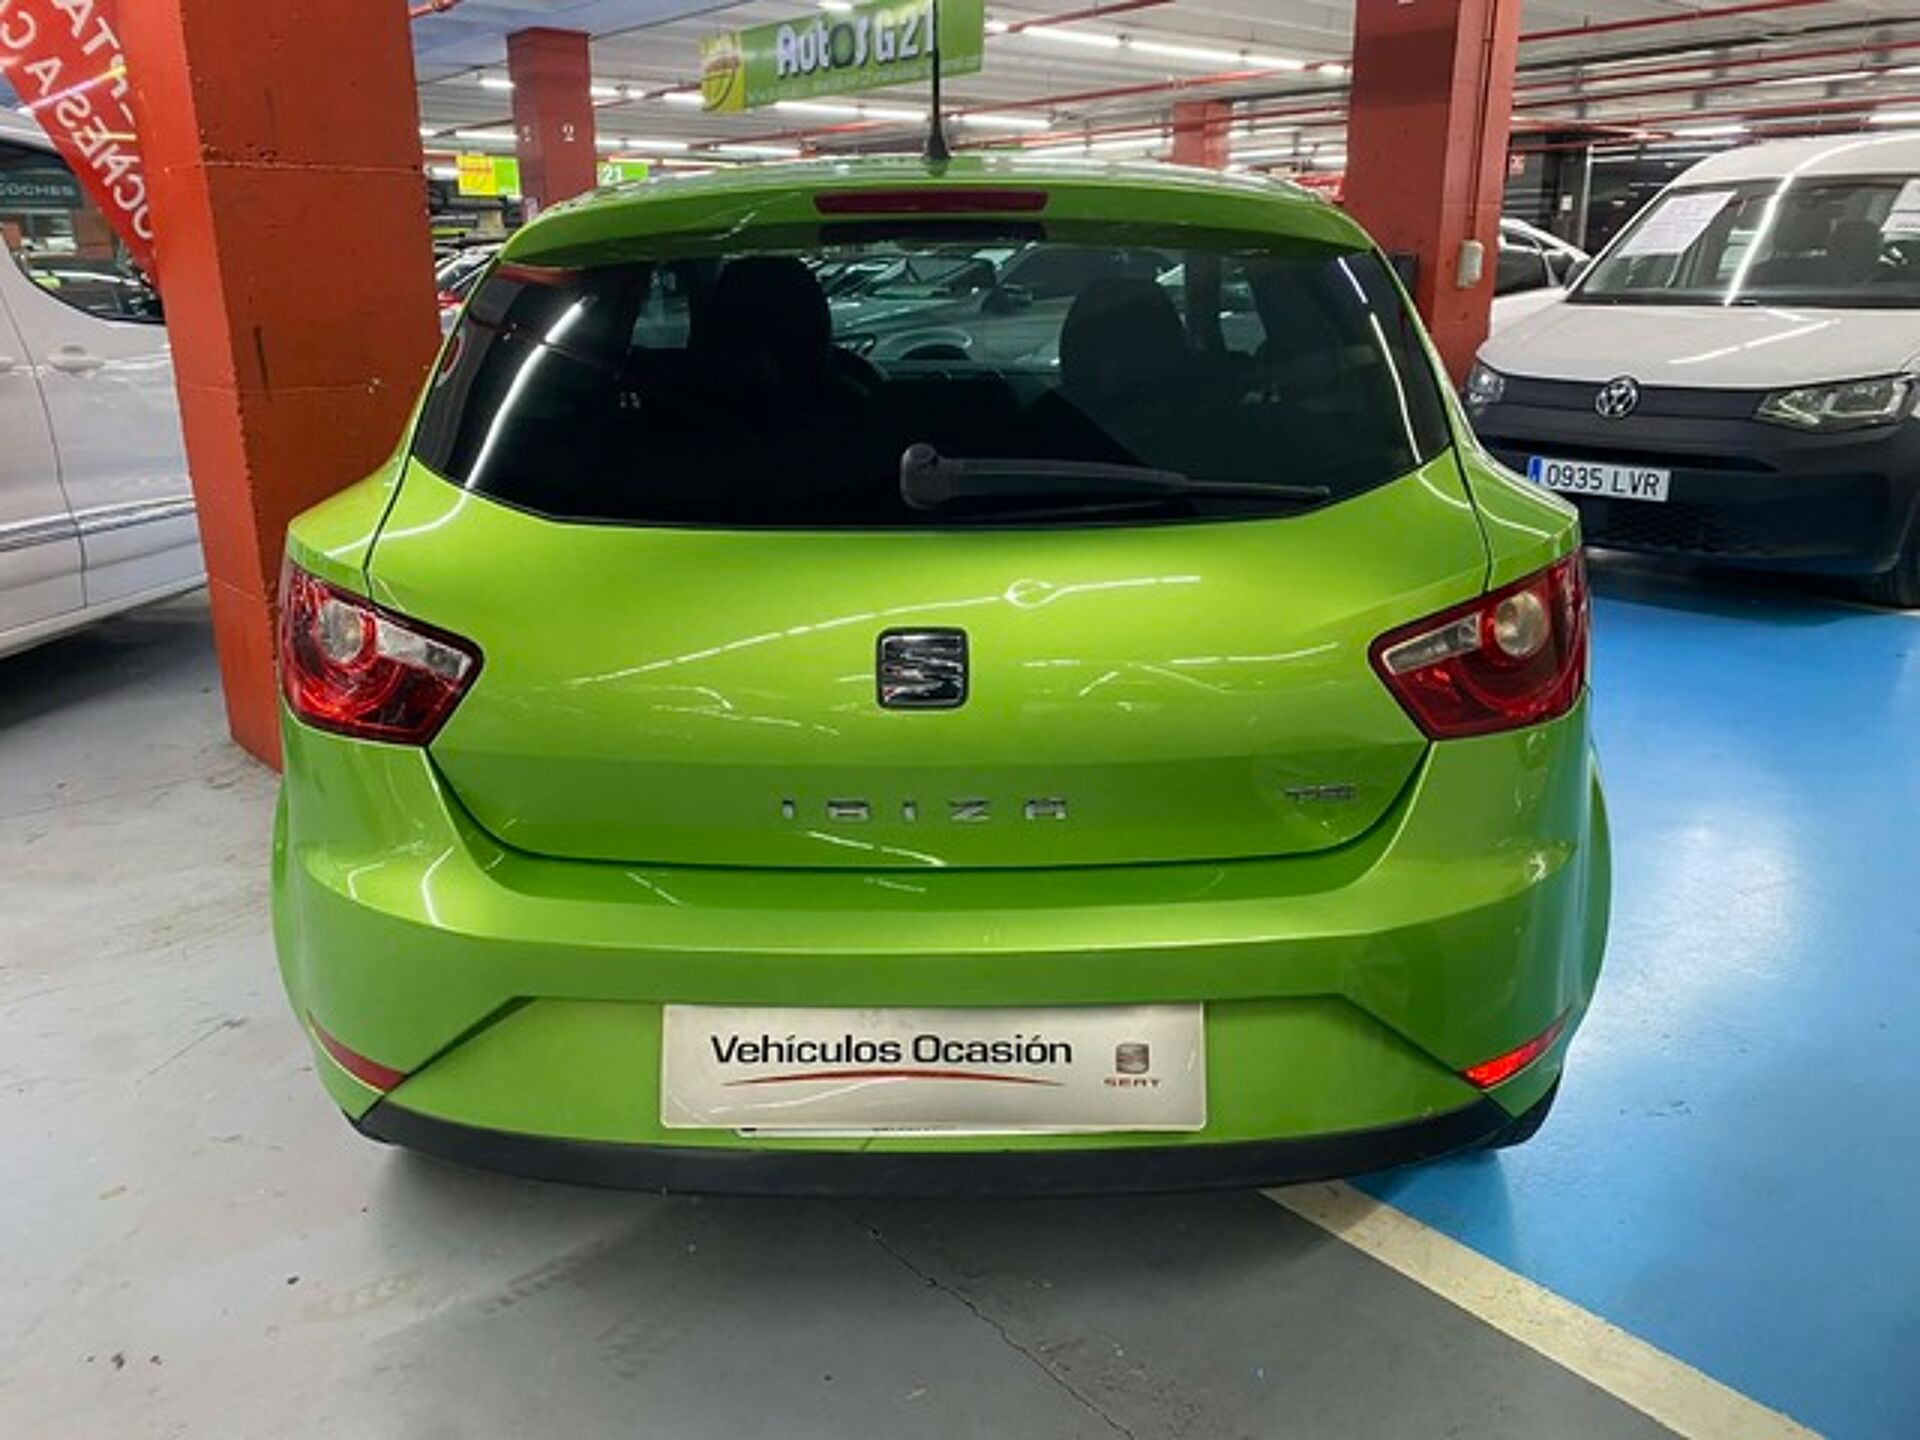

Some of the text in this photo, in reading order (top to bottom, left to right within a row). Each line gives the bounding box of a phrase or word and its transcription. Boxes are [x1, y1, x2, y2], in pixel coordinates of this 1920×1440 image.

[562, 123, 575, 142] 2
[1547, 463, 1660, 496] 0935 LVR
[782, 797, 1067, 822] IBIZA
[711, 1034, 1073, 1063] Vehículos Ocasión
[1103, 1078, 1160, 1088] SEAT
